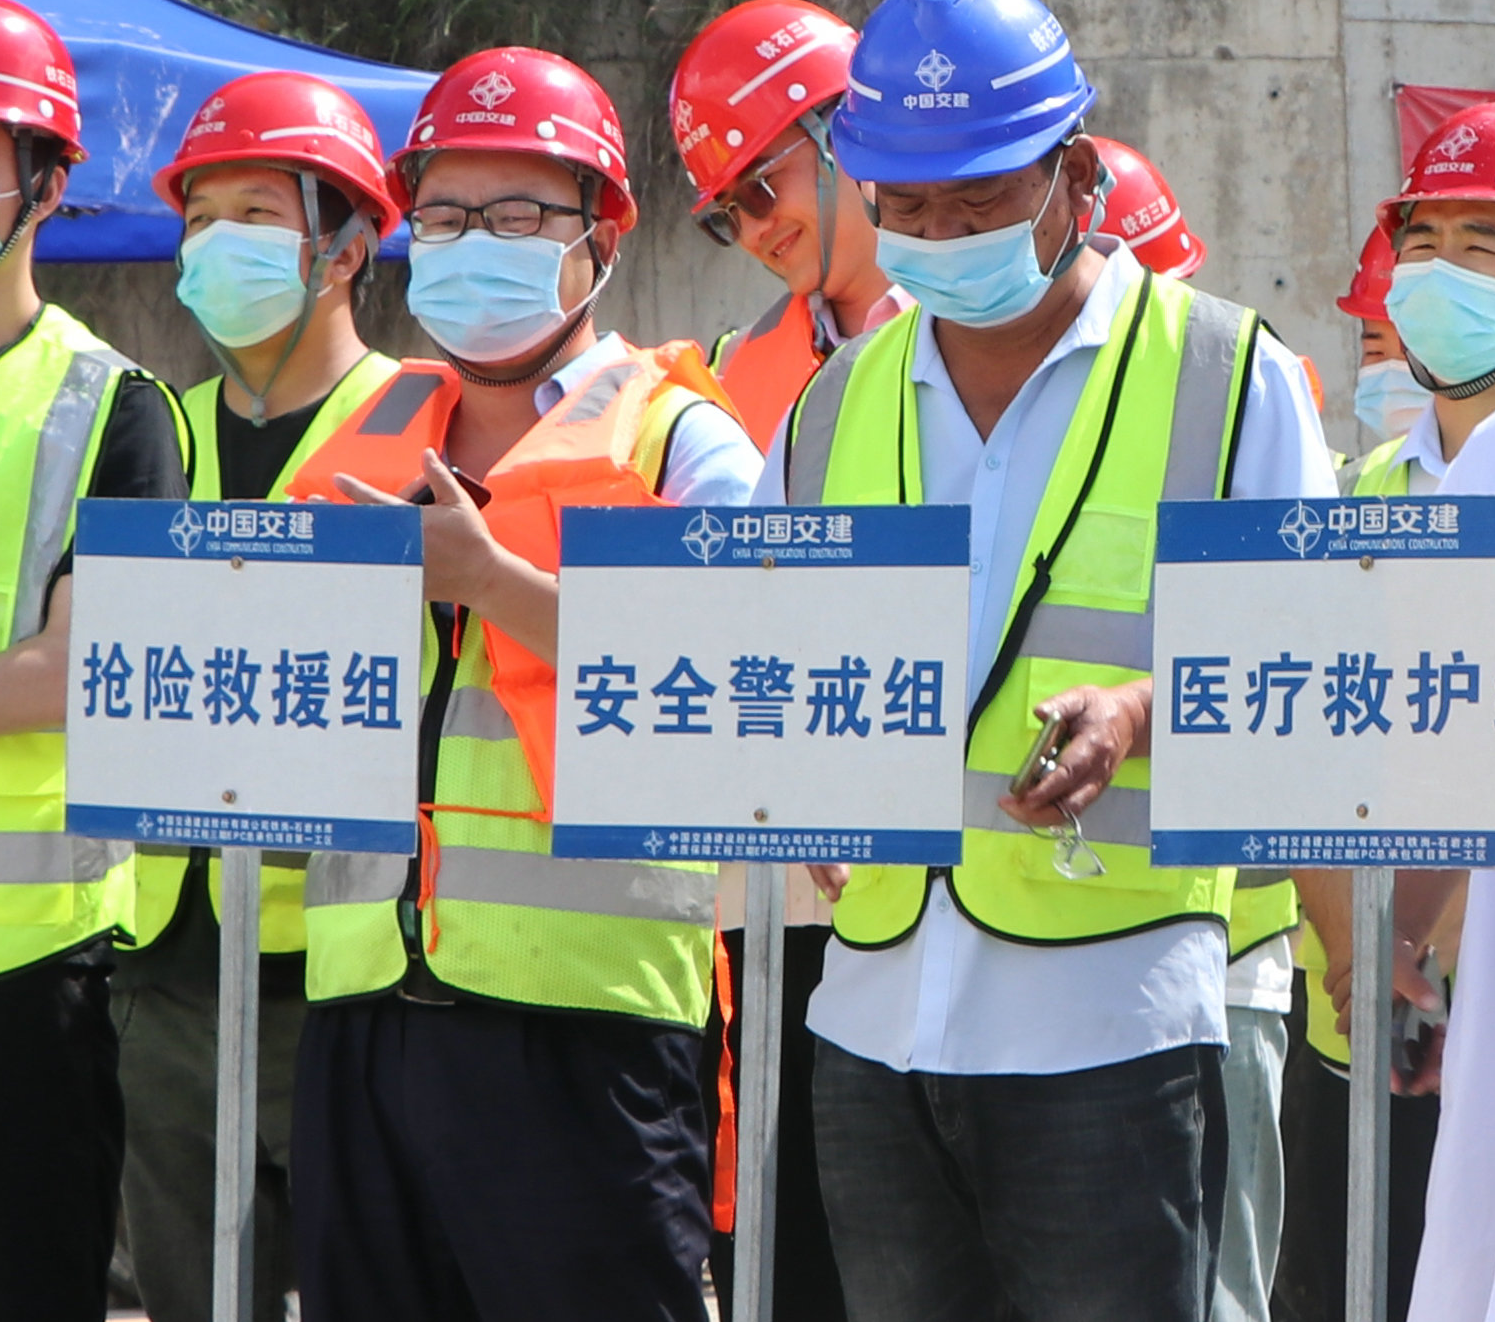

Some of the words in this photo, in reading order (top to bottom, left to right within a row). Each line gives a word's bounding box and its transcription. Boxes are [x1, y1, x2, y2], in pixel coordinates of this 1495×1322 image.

[903, 92, 970, 111] 中国交建
[207, 509, 314, 540] 中国交建
[732, 514, 853, 545] 中国交建
[1328, 503, 1460, 535] 中国交建
[82, 642, 402, 729] 抢险救援组
[574, 654, 947, 738] 安全警戒组
